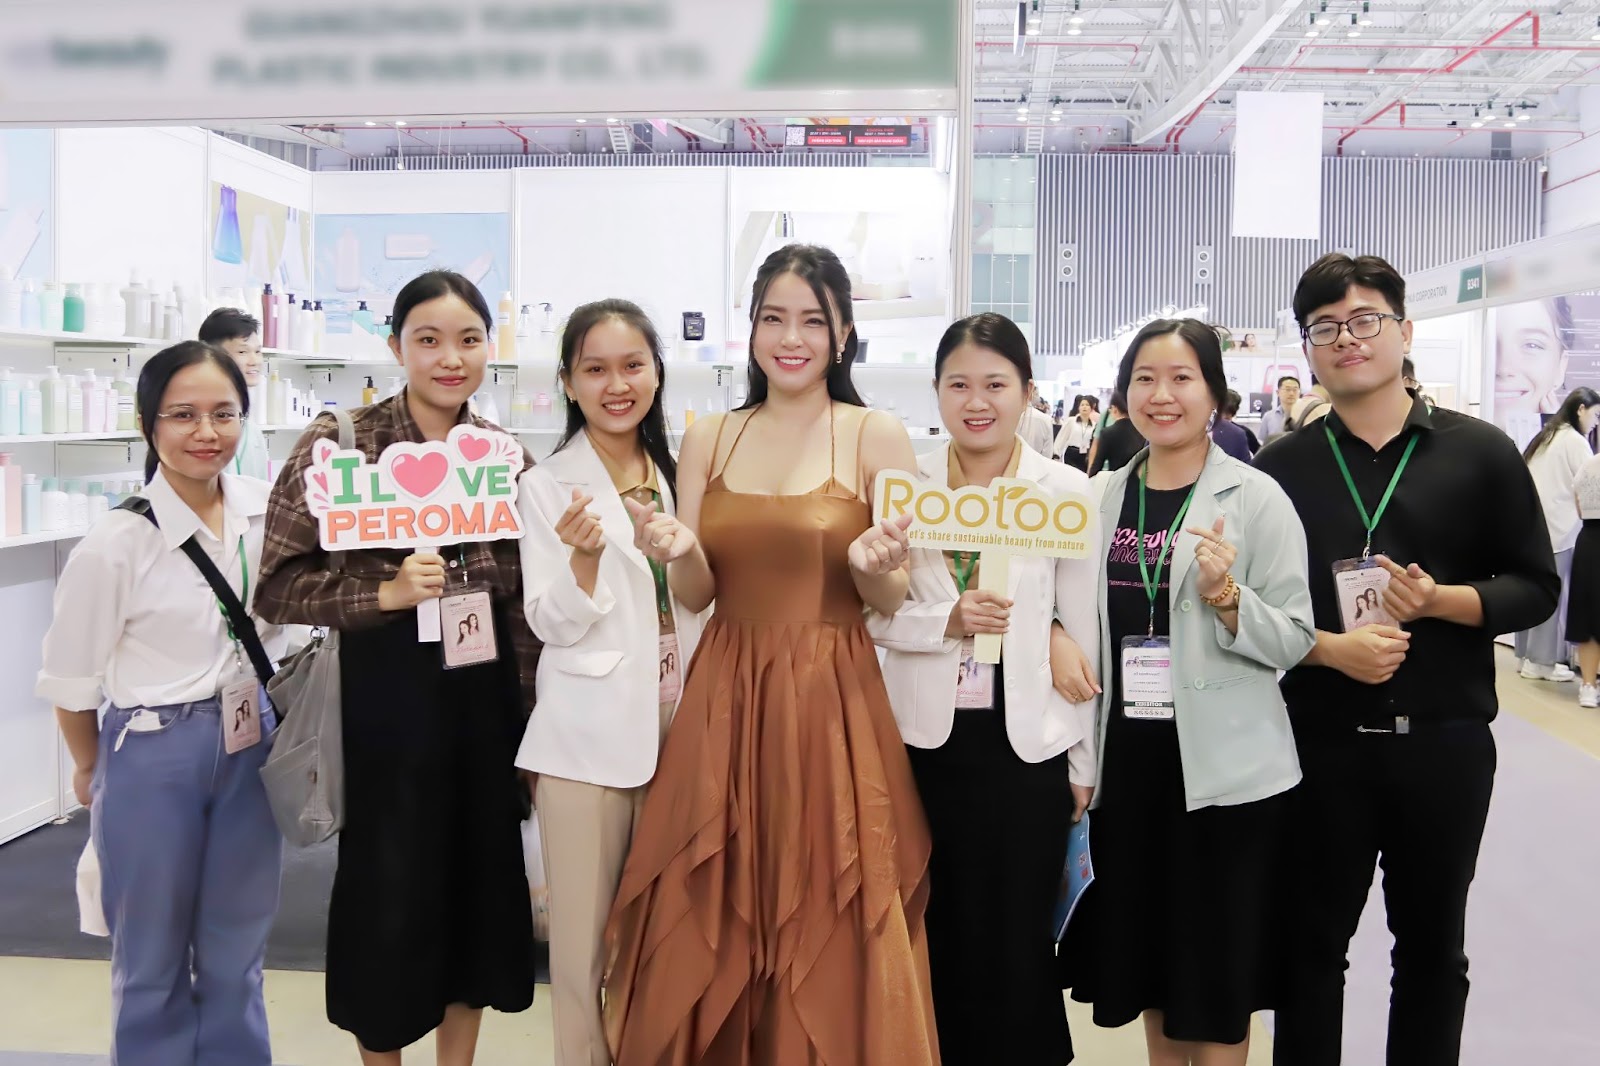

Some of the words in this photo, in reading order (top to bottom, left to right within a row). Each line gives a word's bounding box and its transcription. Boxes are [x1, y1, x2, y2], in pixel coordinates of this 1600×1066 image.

[332, 456, 362, 505] I
[326, 500, 520, 544] PEROMA
[881, 477, 1088, 535] Rootoo
[905, 528, 925, 540] et's
[926, 531, 951, 541] share
[953, 533, 1002, 545] sustainable
[1004, 534, 1032, 549] beauty
[1035, 536, 1056, 549] from
[1057, 539, 1085, 551] nature
